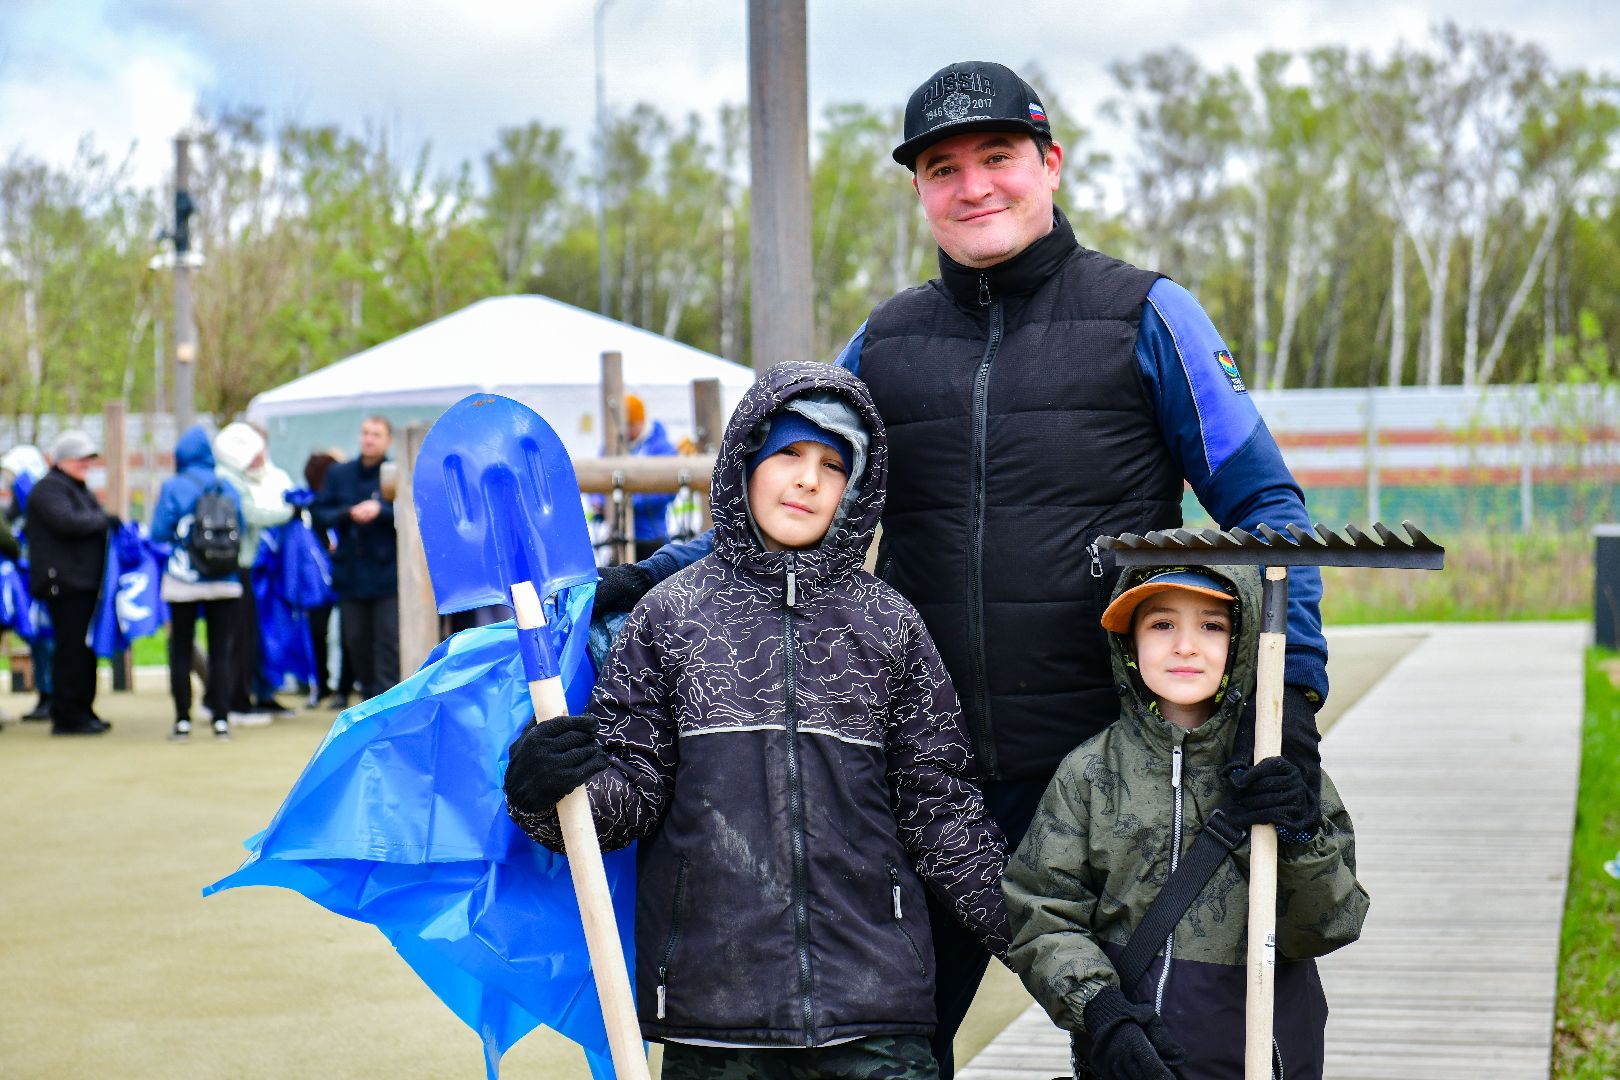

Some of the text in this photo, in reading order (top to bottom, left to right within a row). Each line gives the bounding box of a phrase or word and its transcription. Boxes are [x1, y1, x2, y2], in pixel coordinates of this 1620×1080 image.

[921, 71, 996, 112] RUSSIA
[925, 98, 992, 121] 1946 2017
